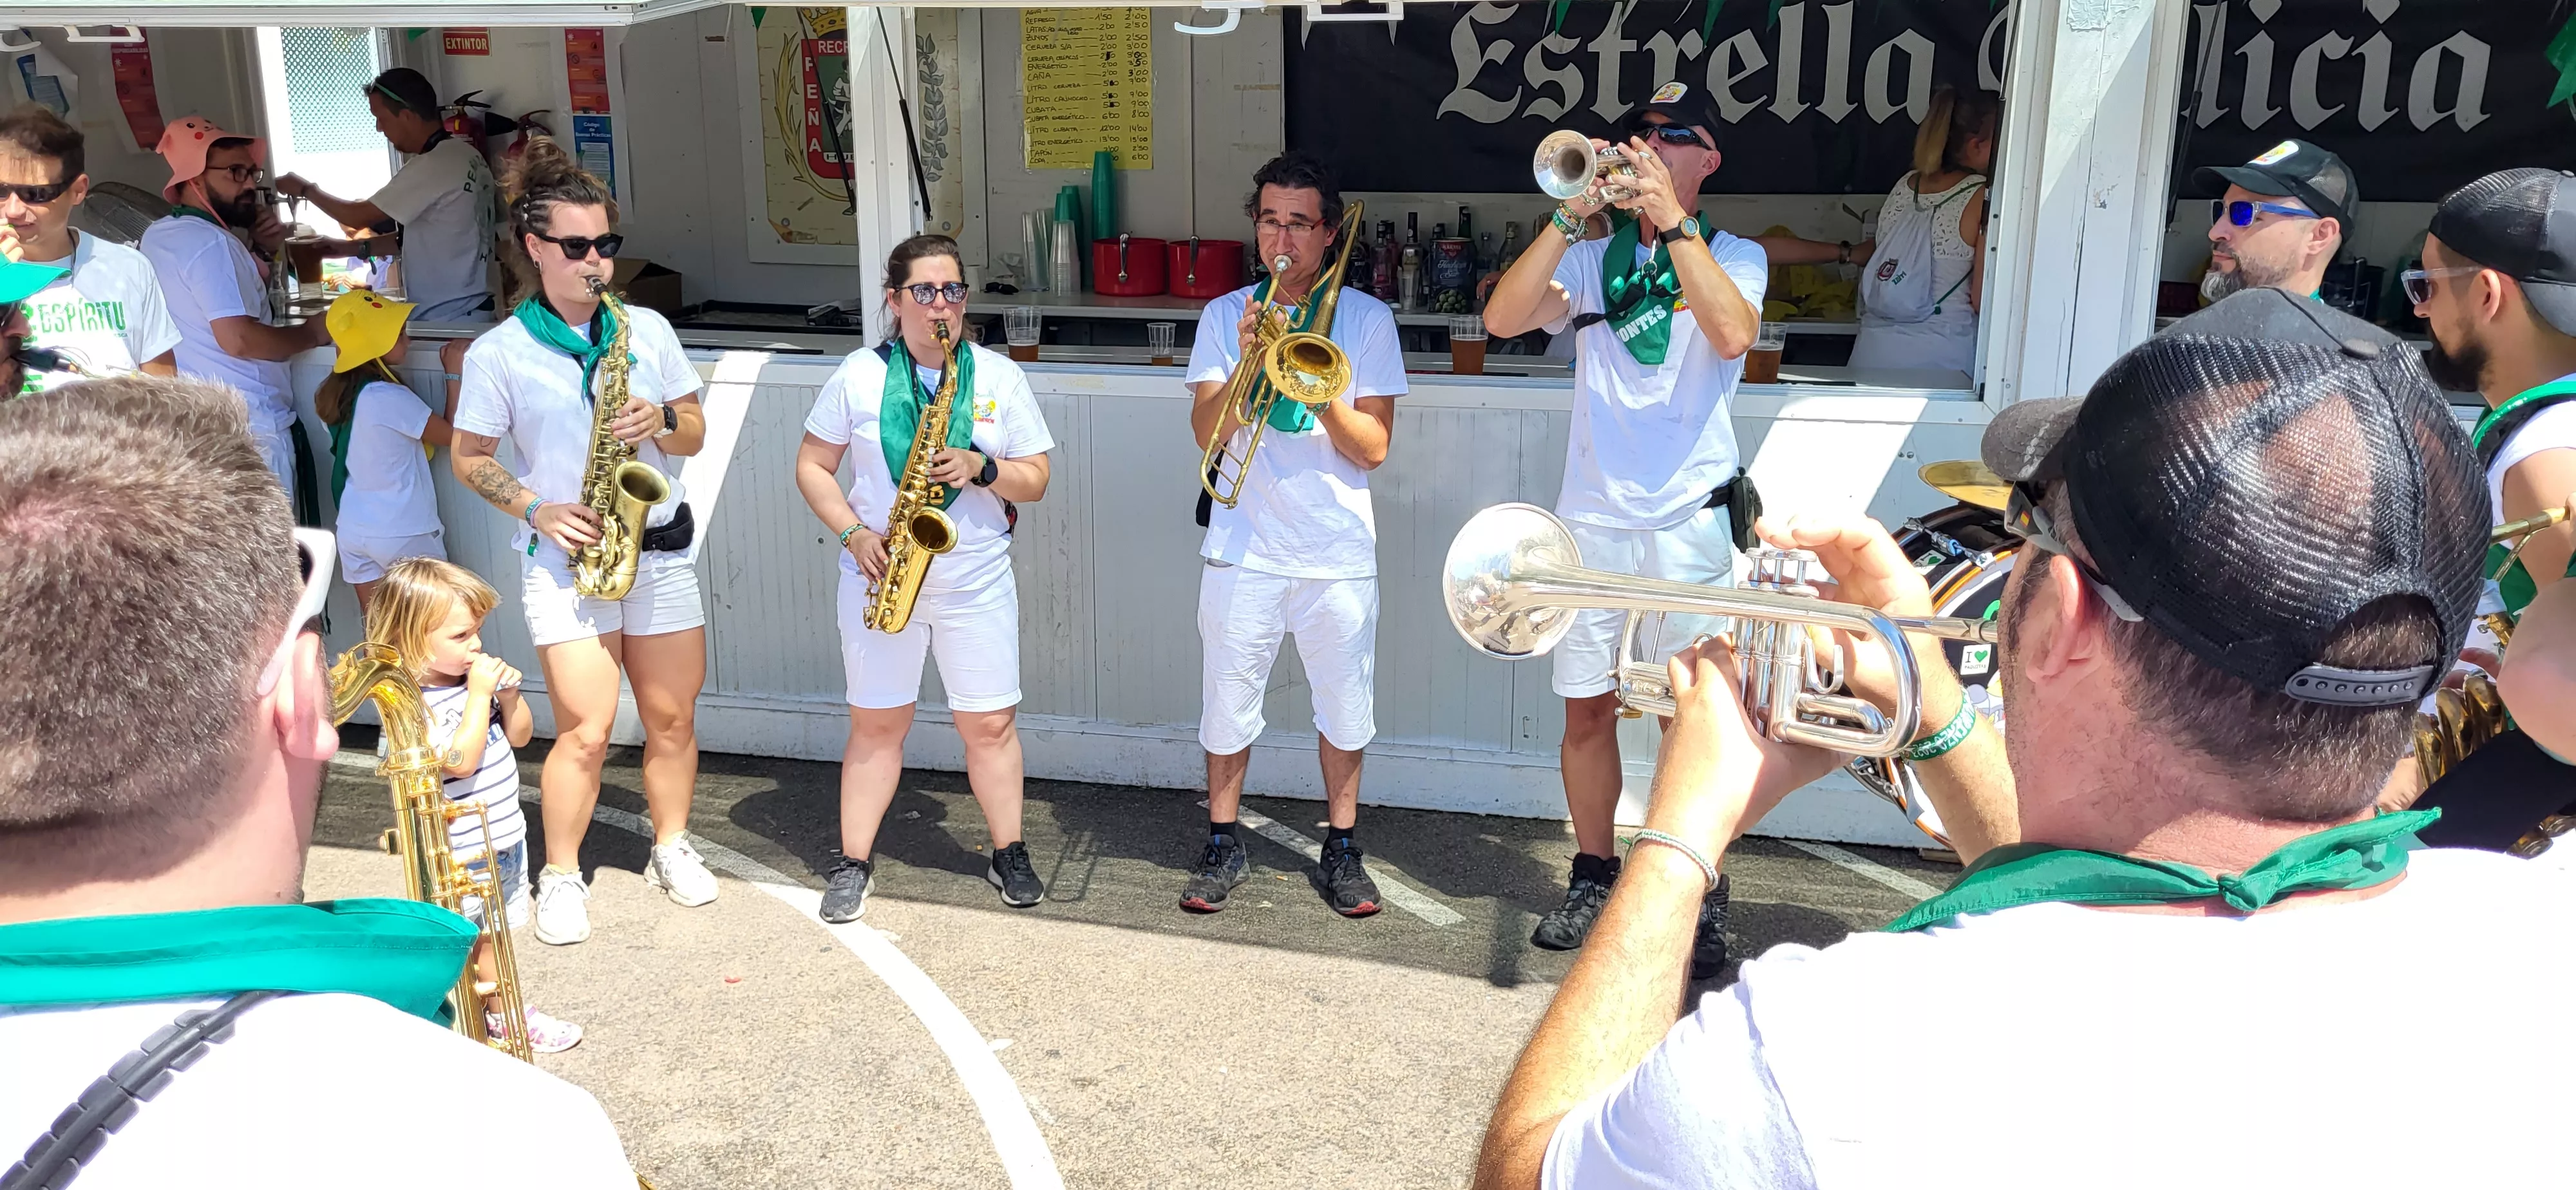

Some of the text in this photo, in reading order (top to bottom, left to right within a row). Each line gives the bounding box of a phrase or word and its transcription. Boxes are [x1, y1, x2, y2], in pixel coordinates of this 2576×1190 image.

[1099, 33, 1117, 42] 2'00
[446, 37, 488, 50] EXTINTOR
[1436, 2, 1936, 125] Estrella
[1028, 68, 1149, 82] CAÑA 2'00 3'00
[1026, 106, 1057, 114] CUBATA
[1102, 111, 1120, 120] 6'00
[1131, 109, 1150, 118] 8'00
[1129, 124, 1148, 133] 14'00
[1099, 135, 1120, 143] 13'00
[1130, 135, 1148, 143] 15'00
[1616, 304, 1667, 343] ONTES
